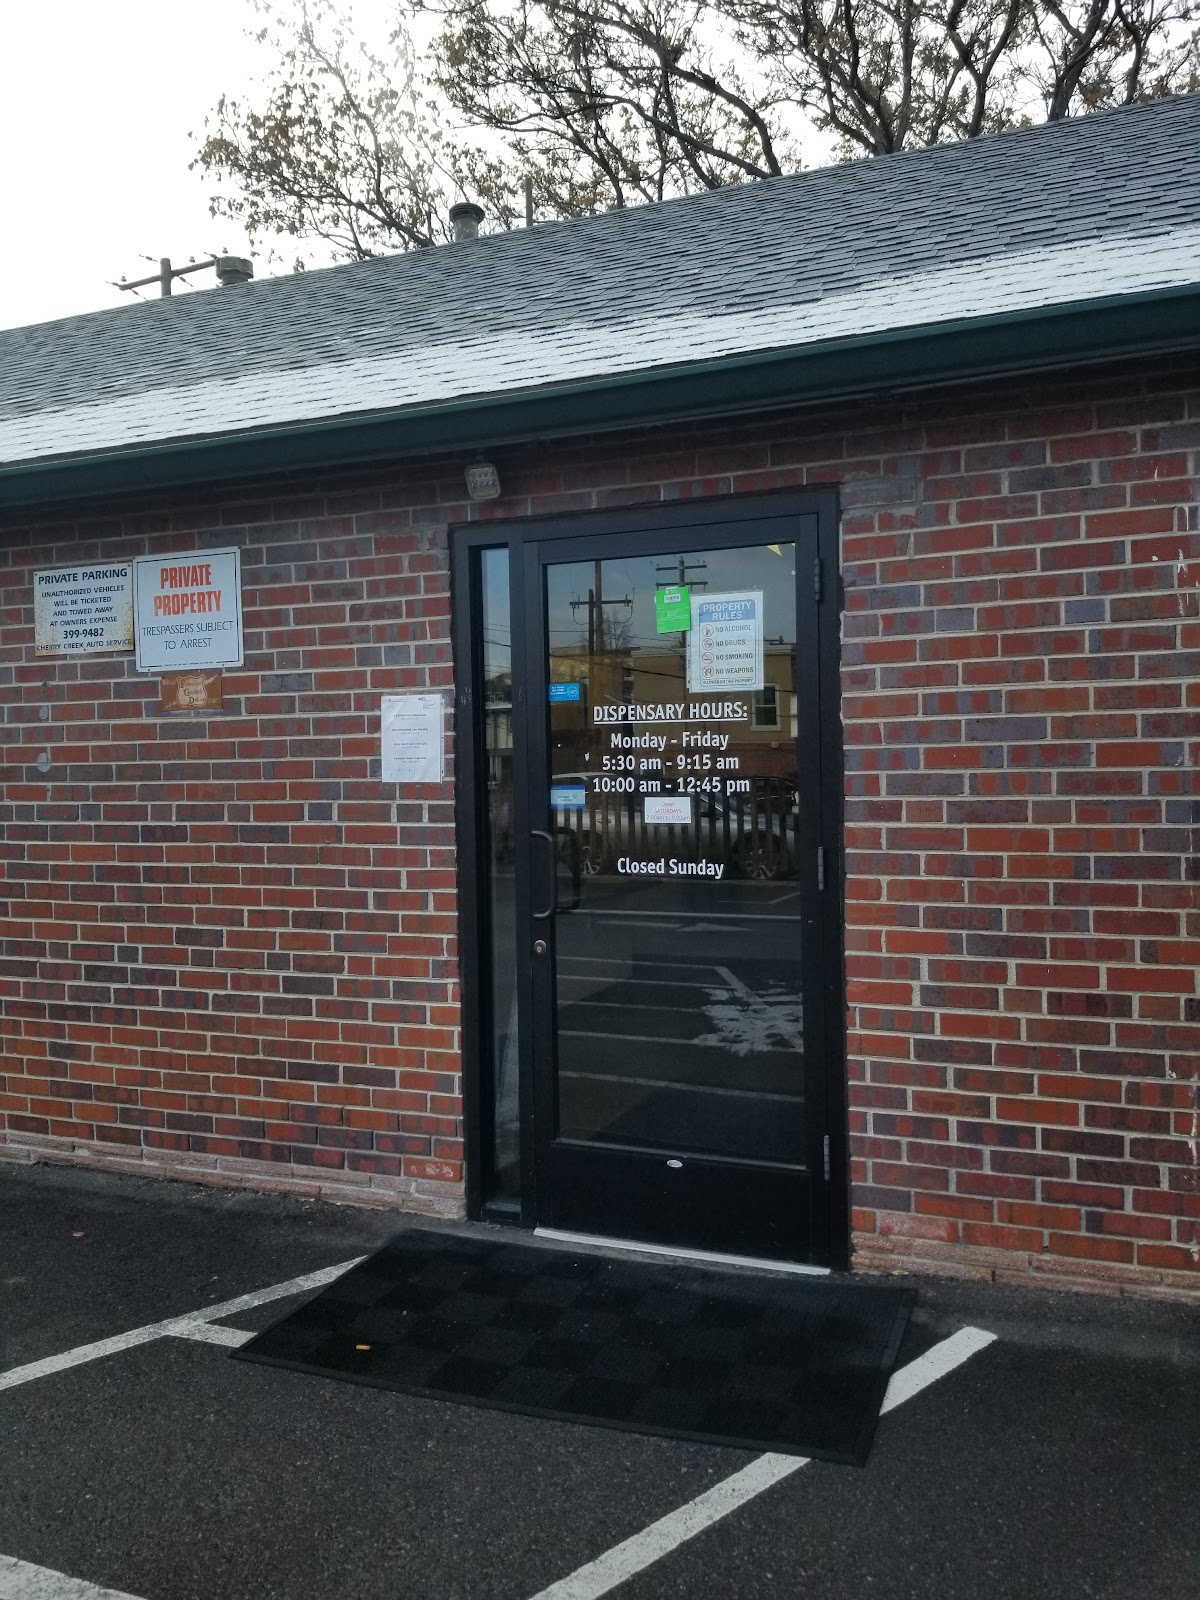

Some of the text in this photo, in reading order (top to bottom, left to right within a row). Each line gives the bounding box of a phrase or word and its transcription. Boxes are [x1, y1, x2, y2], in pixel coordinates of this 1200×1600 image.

[39, 568, 127, 585] PRIVATE PARKING
[161, 564, 211, 589] PRIVATE
[42, 588, 91, 598] UNAUTHORIZED
[154, 590, 221, 616] PROPERTY
[703, 601, 751, 612] PROPERTY
[712, 611, 742, 620] RULES
[64, 628, 104, 639] 399-9482
[142, 621, 233, 636] TRESPASSERS SUBJECT
[164, 638, 212, 649] TO ARREST
[594, 702, 747, 721] DISPENSARY HOURS:
[611, 732, 666, 751] Monday
[682, 731, 729, 750] Friday
[602, 755, 635, 770] 5:30
[640, 758, 661, 770] am
[677, 754, 711, 769] 9:15
[716, 757, 738, 769] am
[593, 777, 635, 792] 10:00
[639, 780, 660, 792] am
[677, 777, 721, 792] 12:45
[726, 780, 750, 796] pm
[618, 858, 724, 879] Closed Sunday
